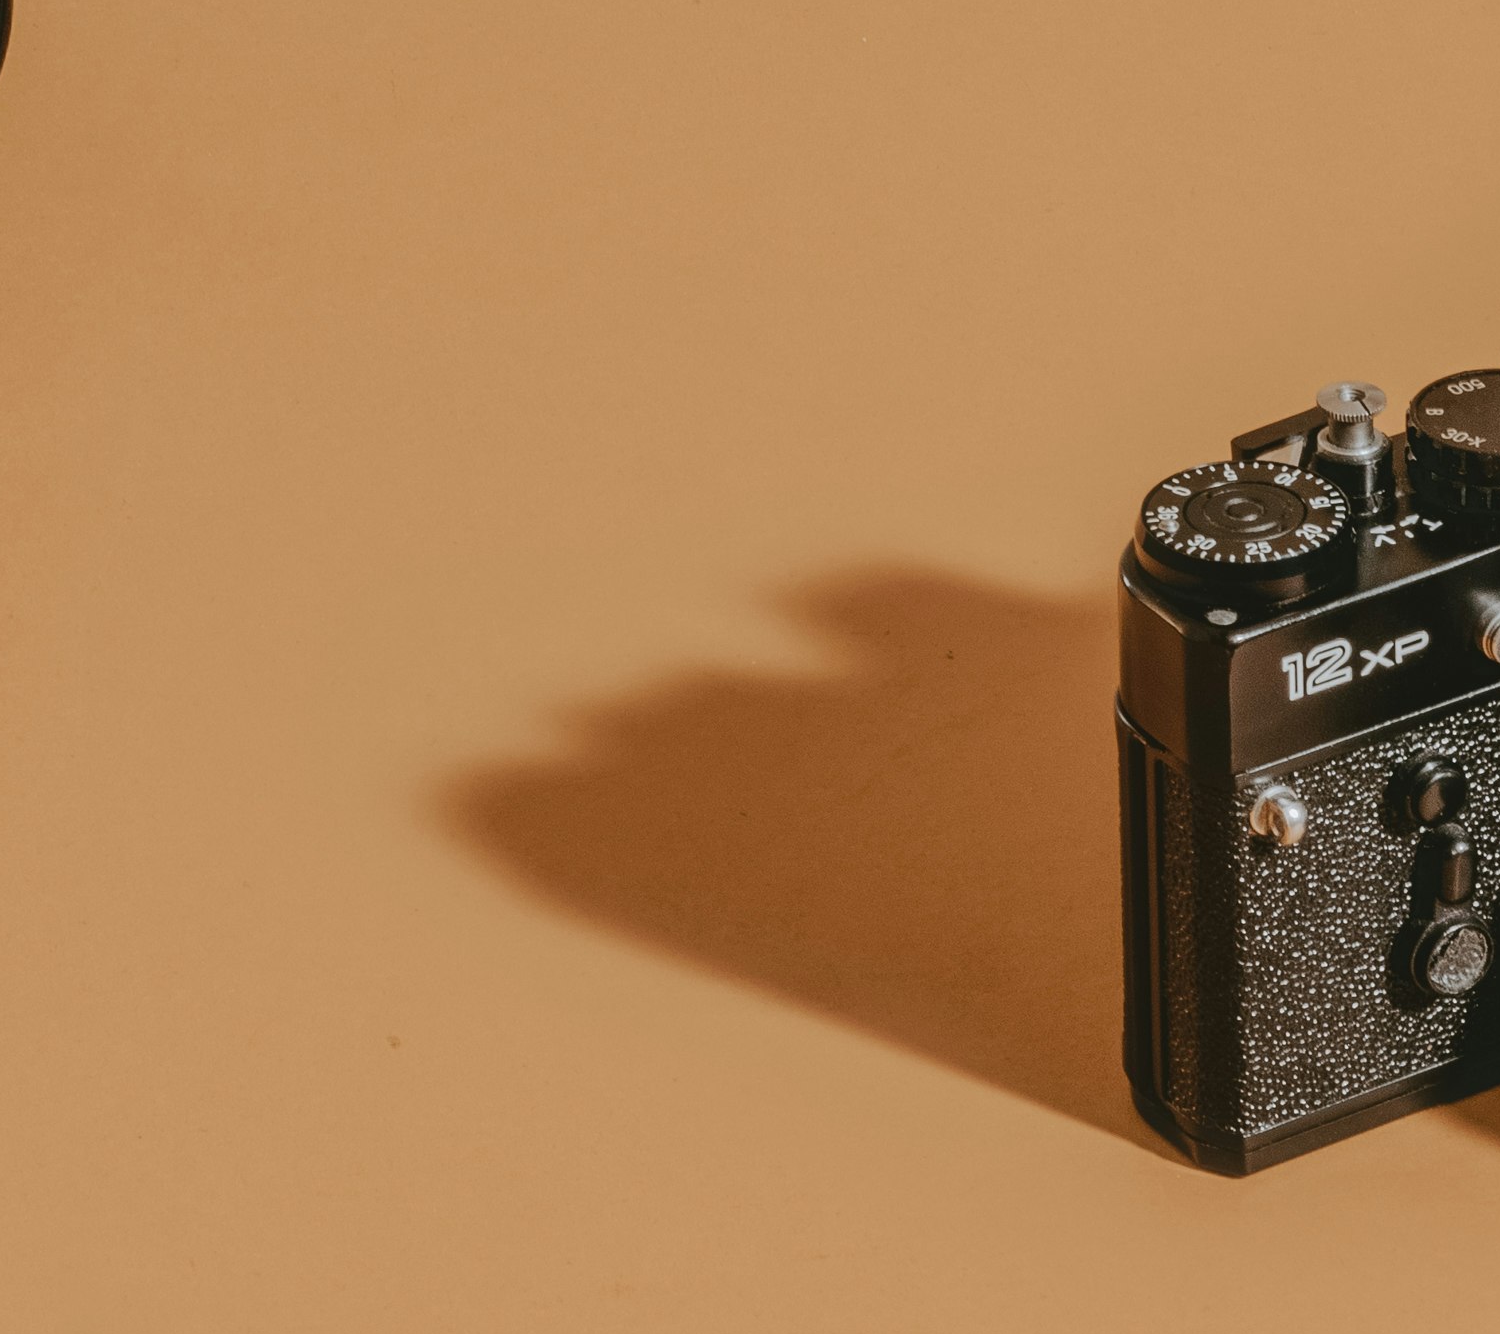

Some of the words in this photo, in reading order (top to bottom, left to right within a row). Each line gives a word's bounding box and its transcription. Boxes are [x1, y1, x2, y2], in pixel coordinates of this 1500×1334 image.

[1447, 379, 1485, 395] 500
[1425, 408, 1444, 418] B
[1273, 473, 1293, 486] 10
[1309, 495, 1329, 510] 15
[1295, 524, 1321, 541] 20
[1187, 533, 1217, 550] 30
[1245, 540, 1272, 555] 25
[1281, 635, 1354, 702] 12
[1359, 630, 1430, 677] XP
